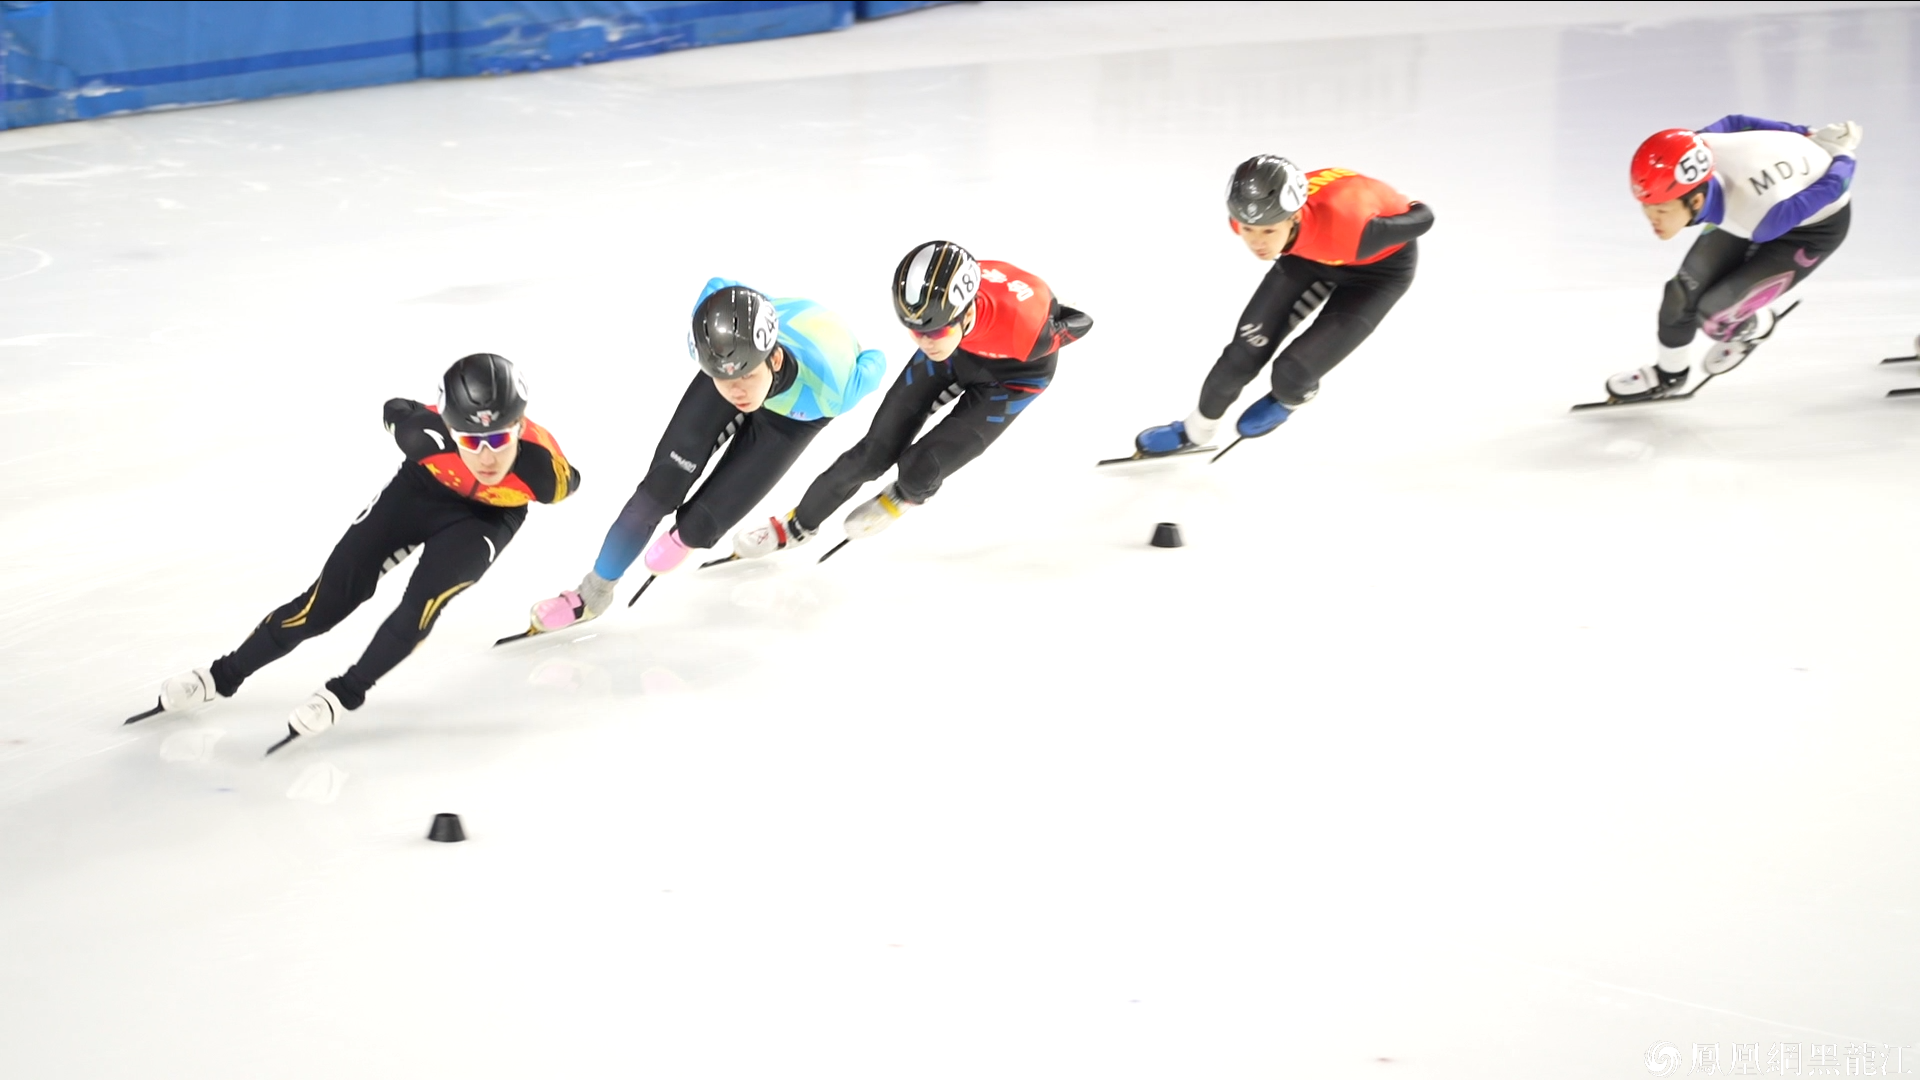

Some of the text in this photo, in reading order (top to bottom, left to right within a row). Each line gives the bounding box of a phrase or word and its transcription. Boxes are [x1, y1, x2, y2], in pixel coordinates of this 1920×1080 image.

[1679, 148, 1709, 182] 59
[1748, 156, 1811, 196] MDJ
[953, 262, 979, 301] 187
